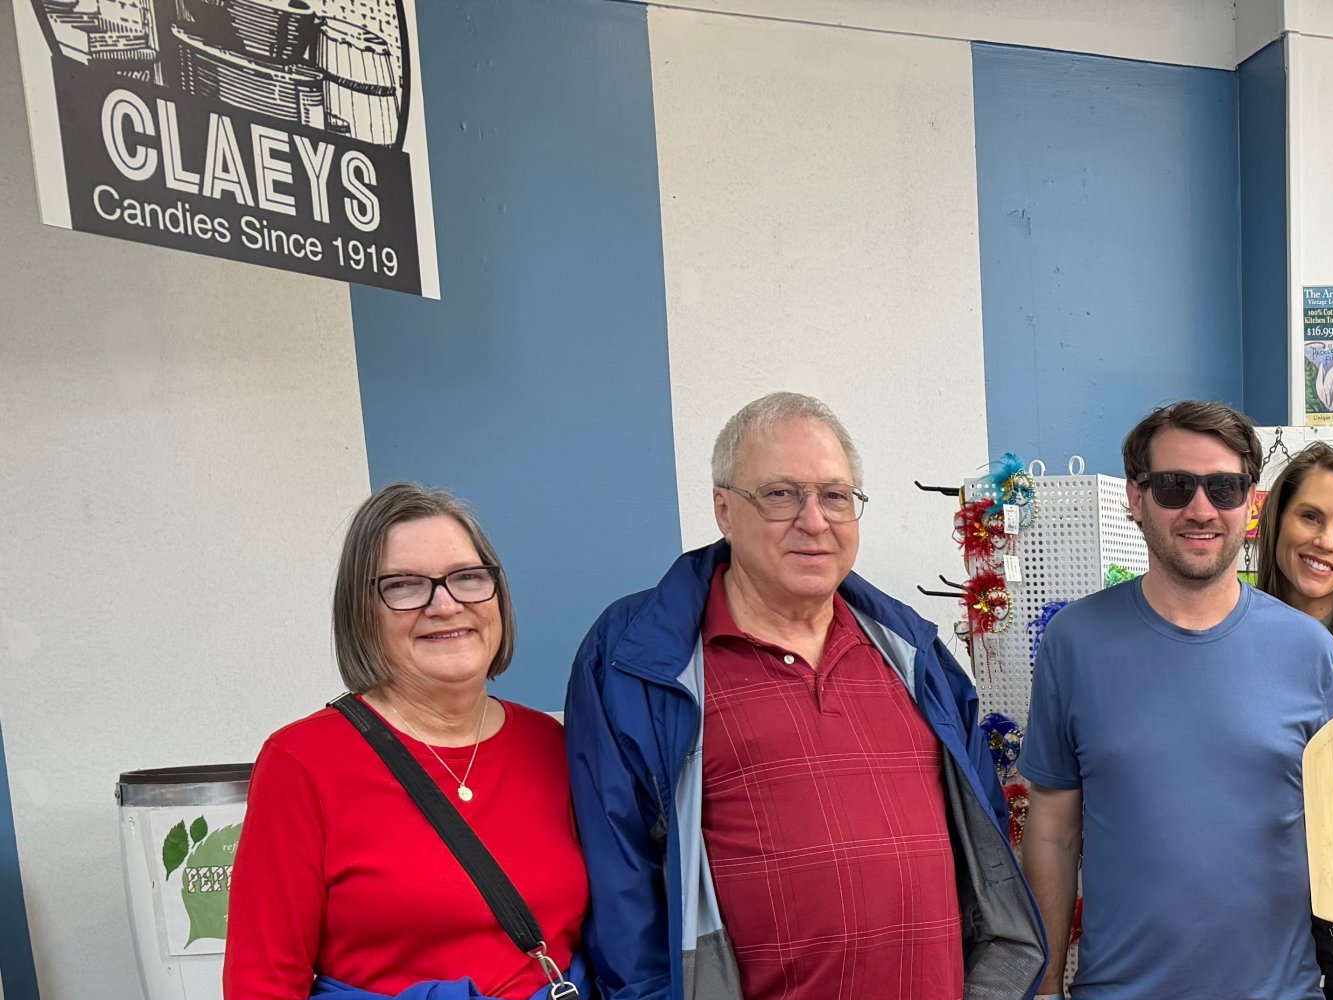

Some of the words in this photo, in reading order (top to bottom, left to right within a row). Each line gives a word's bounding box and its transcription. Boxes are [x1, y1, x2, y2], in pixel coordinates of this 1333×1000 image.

[101, 89, 381, 232] CLAEYS
[93, 184, 232, 243] Candies
[240, 215, 323, 261] Since
[332, 237, 399, 277] 1919
[1304, 289, 1320, 298] The
[1304, 316, 1325, 324] Kitchen
[1307, 326, 1333, 337] $16.99
